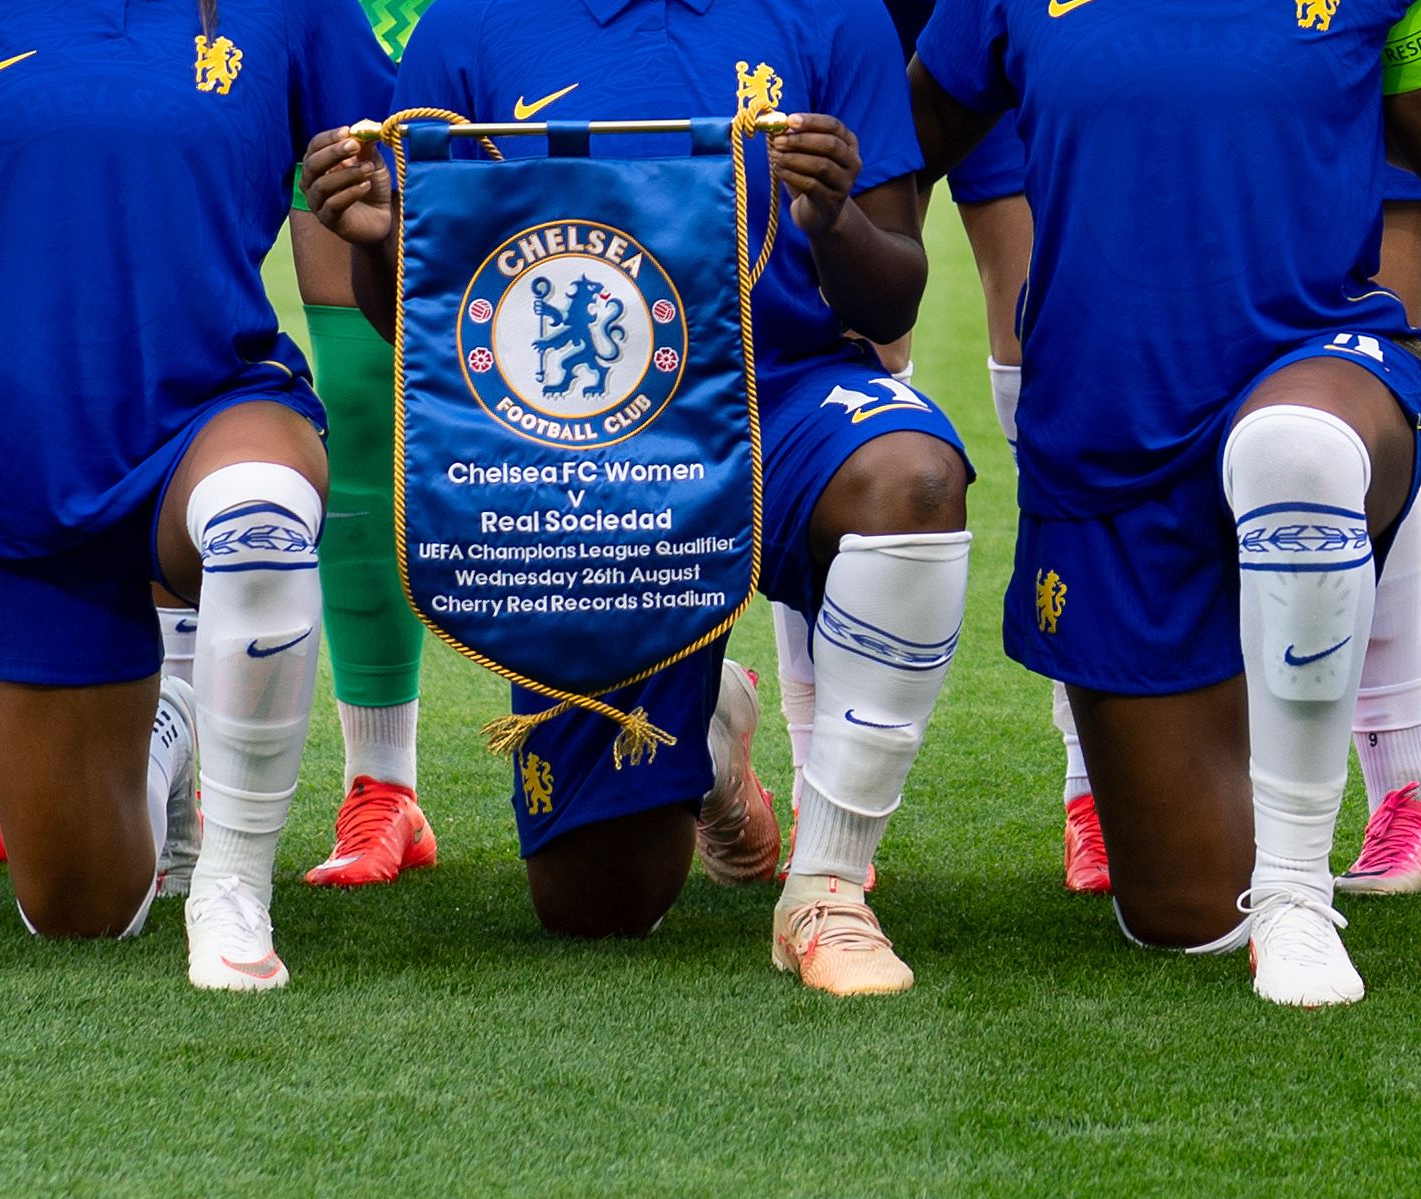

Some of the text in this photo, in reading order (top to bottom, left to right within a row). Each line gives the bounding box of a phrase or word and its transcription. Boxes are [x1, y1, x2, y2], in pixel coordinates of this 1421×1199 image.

[496, 225, 644, 280] CHELSEA
[495, 394, 653, 441] FOOTBALL CLUB
[447, 460, 705, 485] Chelsea FC Women
[480, 508, 673, 533] Real Sociedad
[418, 536, 736, 564] UEFA Champions League Qualifier
[455, 563, 701, 590] Wednesday 26th August
[431, 590, 726, 618] Cherry Red Records Stadium
